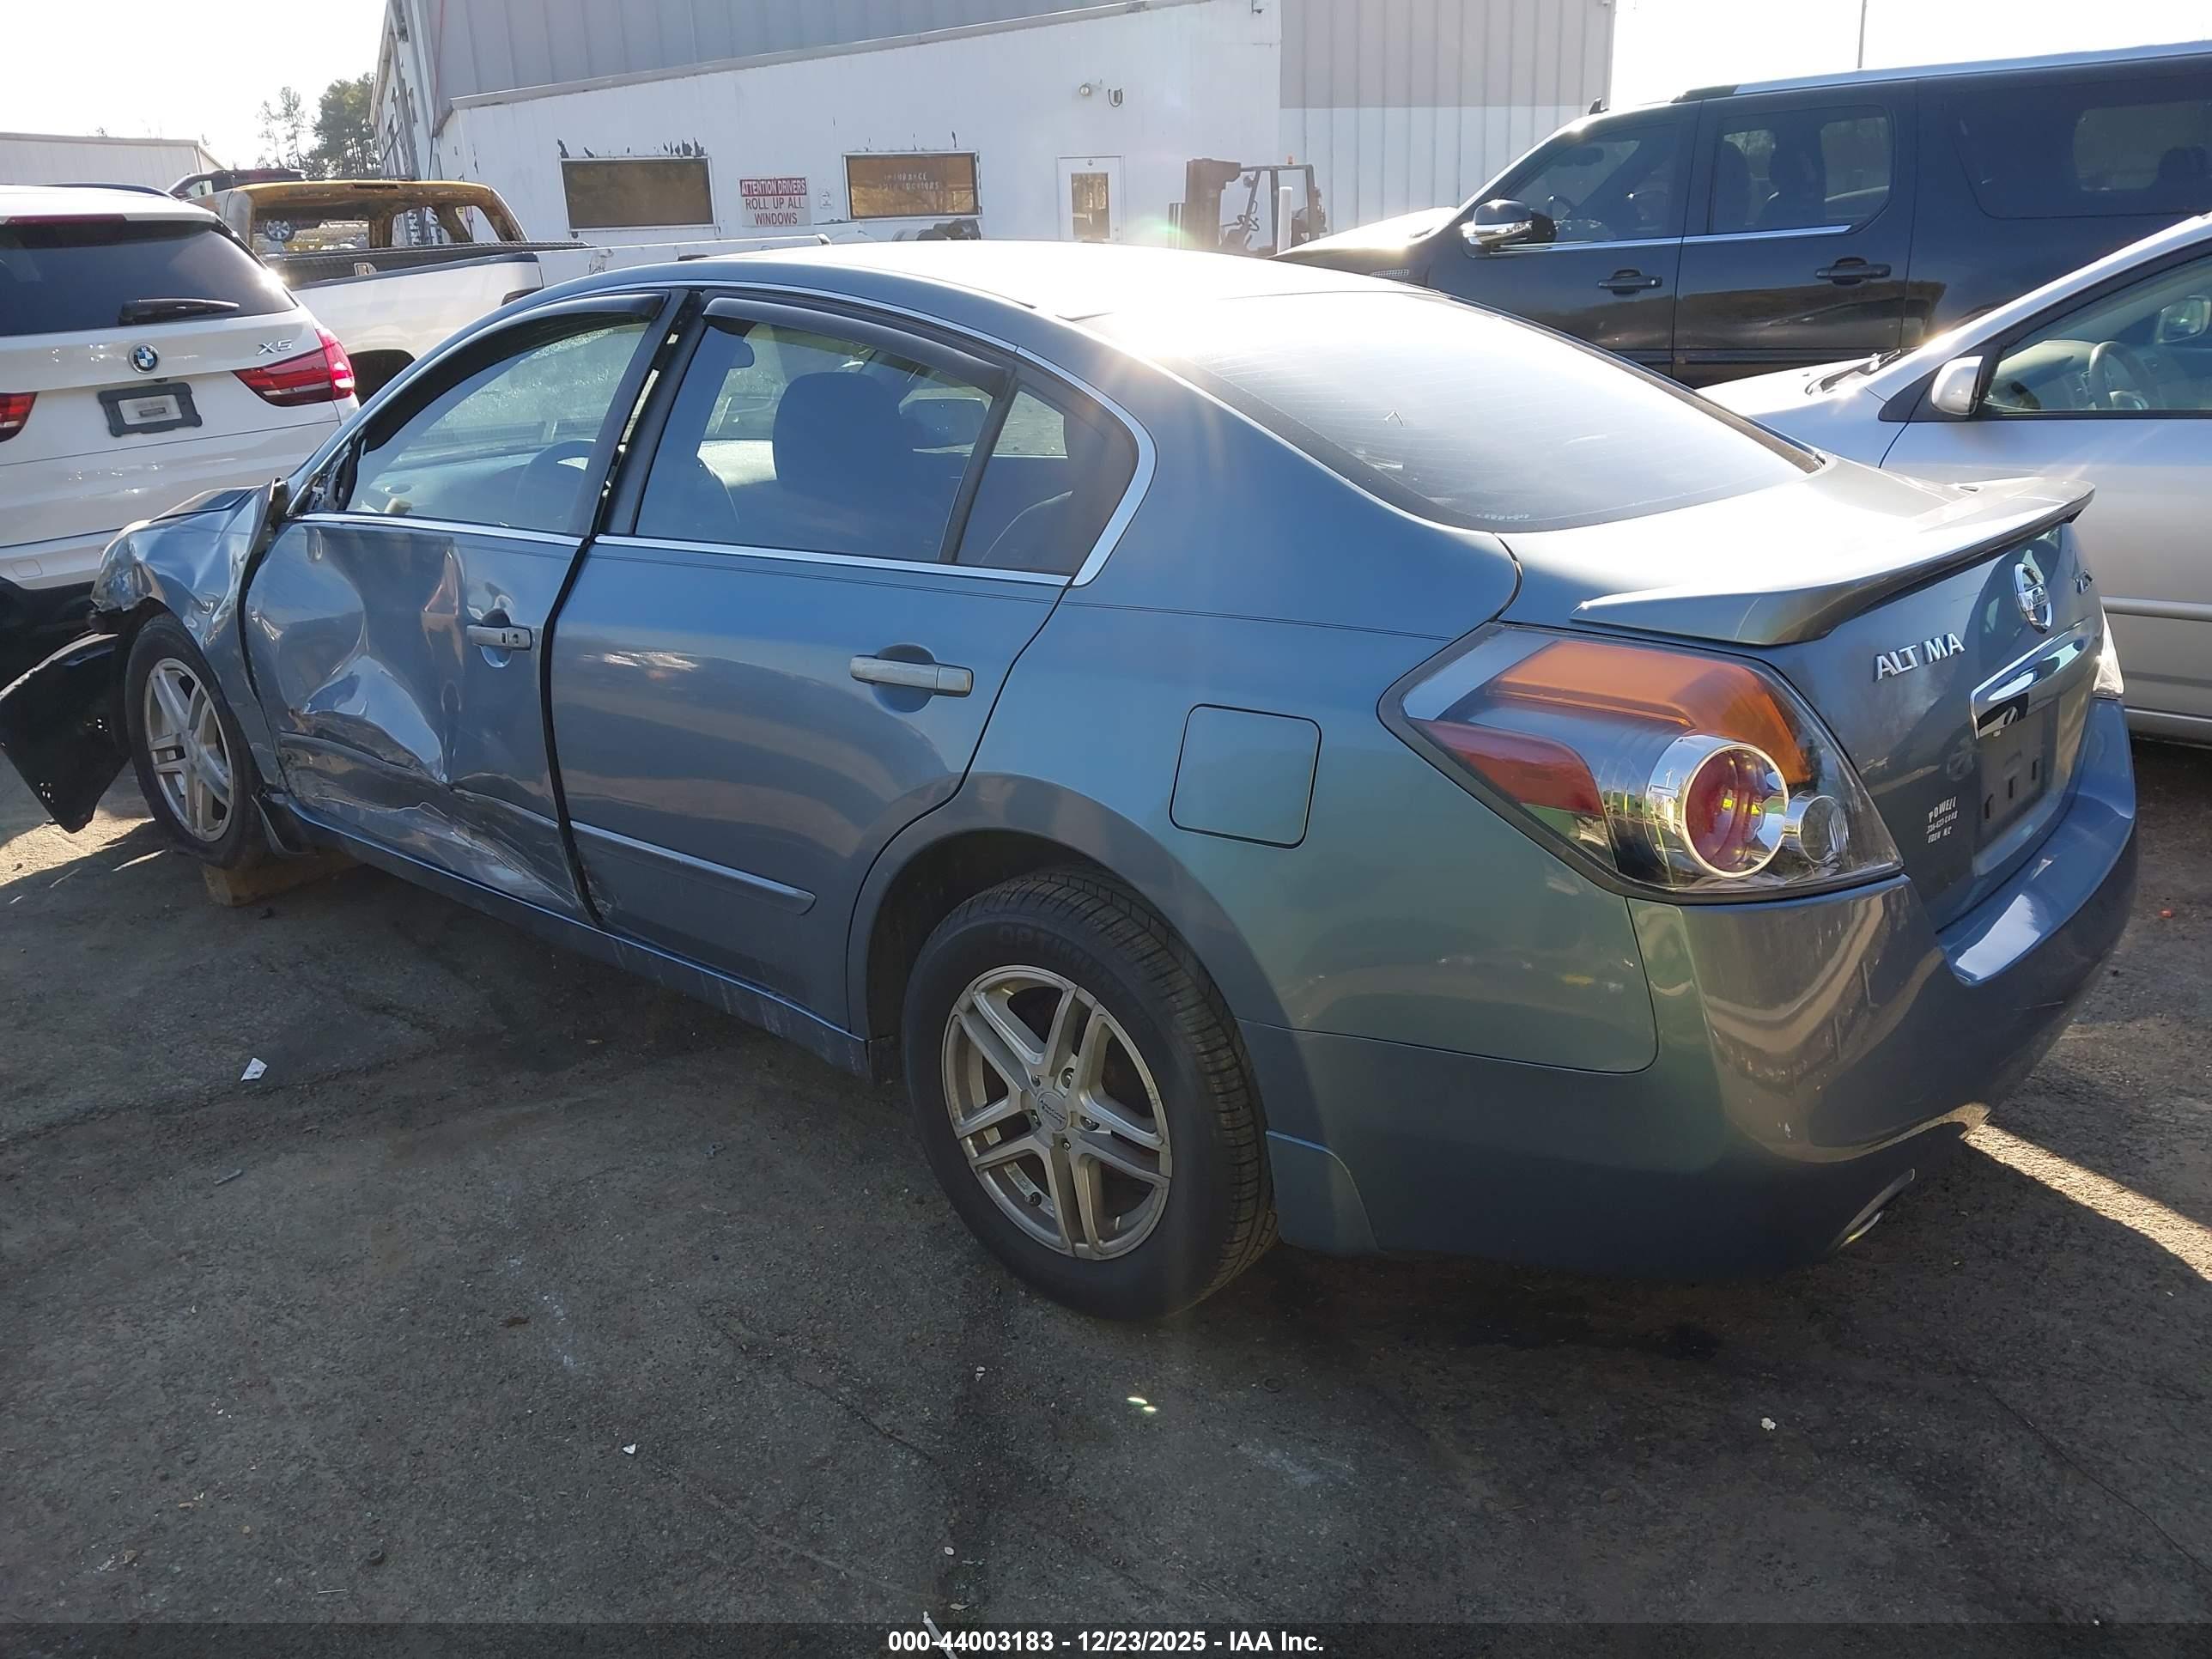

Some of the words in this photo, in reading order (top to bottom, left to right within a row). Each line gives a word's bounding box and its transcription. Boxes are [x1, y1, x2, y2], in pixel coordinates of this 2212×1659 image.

[741, 178, 777, 195] ATTENTION
[778, 176, 805, 194] DRIVERS
[745, 198, 769, 210] ROLL
[773, 197, 785, 210] UP
[787, 196, 805, 209] ALL
[755, 212, 798, 225] WINDOWS
[257, 339, 293, 356] X5
